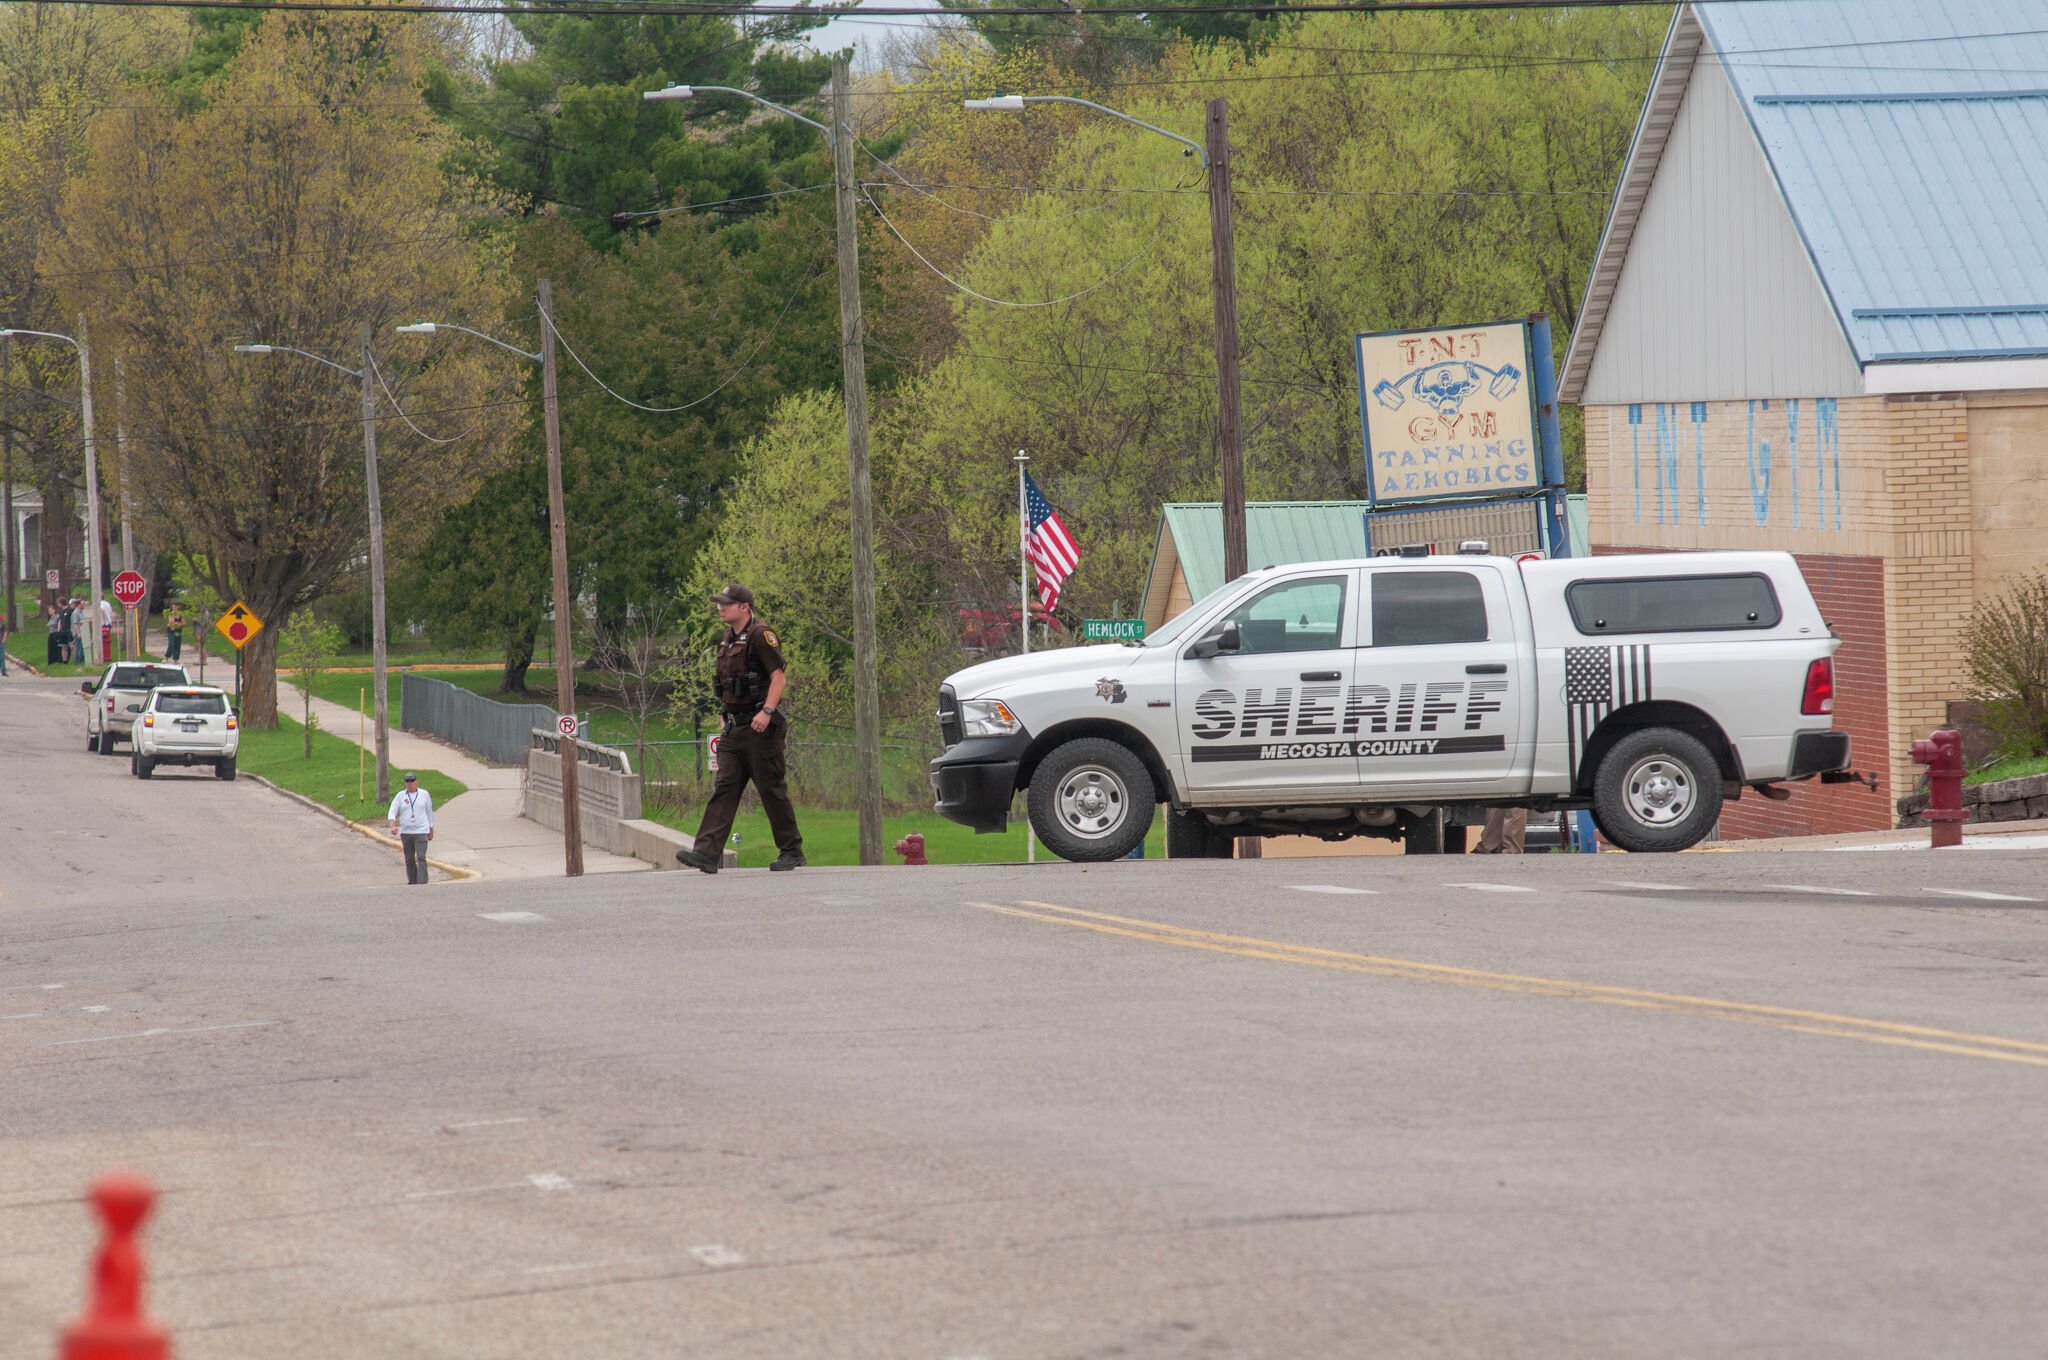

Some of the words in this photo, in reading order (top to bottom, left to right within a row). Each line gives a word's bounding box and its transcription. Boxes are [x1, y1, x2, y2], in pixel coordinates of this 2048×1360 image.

[1408, 410, 1497, 444] GYM
[1377, 438, 1528, 468] TANNING
[1747, 397, 1841, 531] GYM
[1382, 462, 1530, 493] AEROBICS
[115, 580, 144, 594] STOP
[1087, 622, 1135, 637] HEMLOCK
[1191, 680, 1509, 740] SHERIFF
[1259, 742, 1352, 760] MECOSTA
[1356, 739, 1440, 756] COUNTY
